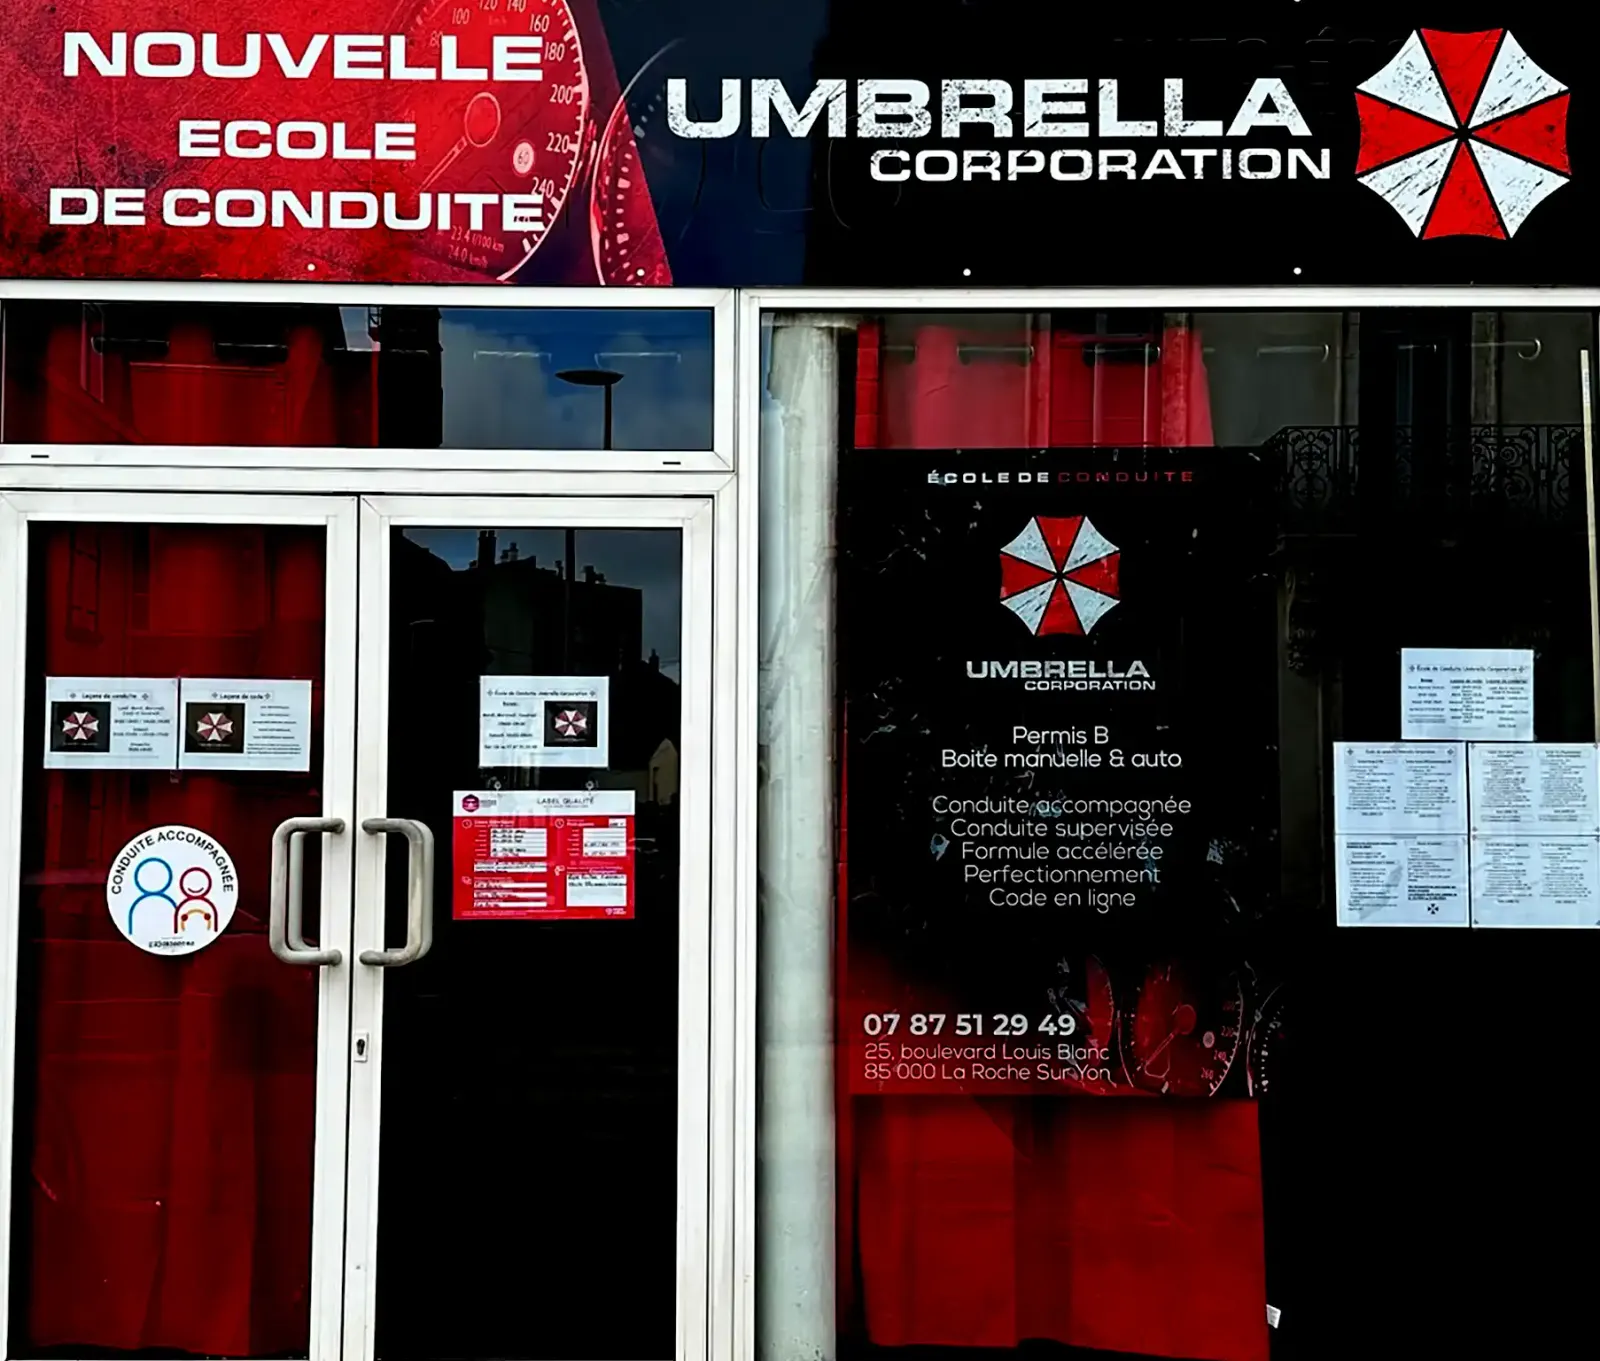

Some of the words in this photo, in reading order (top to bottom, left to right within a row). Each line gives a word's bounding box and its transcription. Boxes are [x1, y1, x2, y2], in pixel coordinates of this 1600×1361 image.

[529, 14, 549, 32] 160
[64, 32, 543, 81] NOUVELLE
[544, 42, 565, 61] 180
[551, 84, 573, 104] 200
[666, 78, 1311, 139] UMBRELLA
[178, 120, 416, 160] ECOLE
[546, 133, 570, 154] 220
[870, 148, 1330, 182] CORPORATION
[531, 177, 555, 198] 240
[49, 189, 146, 226] DE
[163, 190, 545, 231] CONDUITE
[927, 470, 1010, 484] ÉCOLE
[1018, 472, 1049, 483] DE
[1058, 471, 1194, 483] CONDUITE
[966, 660, 1150, 679] UMBRELLA
[1024, 680, 1156, 691] CORPORATION
[1013, 725, 1087, 744] Permis
[1094, 726, 1109, 744] B
[942, 749, 998, 767] Boite
[1004, 748, 1102, 767] manuelle
[1109, 749, 1125, 767] &
[1131, 750, 1182, 767] auto
[932, 795, 1029, 813] Conduite
[1036, 796, 1191, 820] accompagnée
[950, 818, 1048, 836] Conduite
[1055, 818, 1174, 840] supervisée
[962, 841, 1049, 859] Formule
[1056, 841, 1164, 859] accélérée
[111, 835, 156, 895] CONDUITE
[157, 830, 234, 892] ACCOMPAGNÉE
[964, 864, 1161, 883] Perfectionnement
[989, 887, 1047, 906] Code
[1054, 893, 1081, 906] en
[1088, 888, 1136, 914] ligne
[863, 1014, 900, 1036] 07
[909, 1014, 946, 1036] 87
[955, 1014, 983, 1036] 51
[993, 1014, 1028, 1036] 29
[1038, 1014, 1076, 1036] 49
[864, 1043, 895, 1061] 25,
[901, 1043, 996, 1060] boulevard
[1002, 1043, 1051, 1060] Louis
[1058, 1043, 1110, 1061] Blanc
[864, 1063, 891, 1080] 85
[898, 1063, 936, 1080] 000
[942, 1064, 965, 1080] La
[972, 1064, 1030, 1080] Roche
[1037, 1063, 1070, 1080] Sur
[1079, 1063, 1111, 1081] Yon
